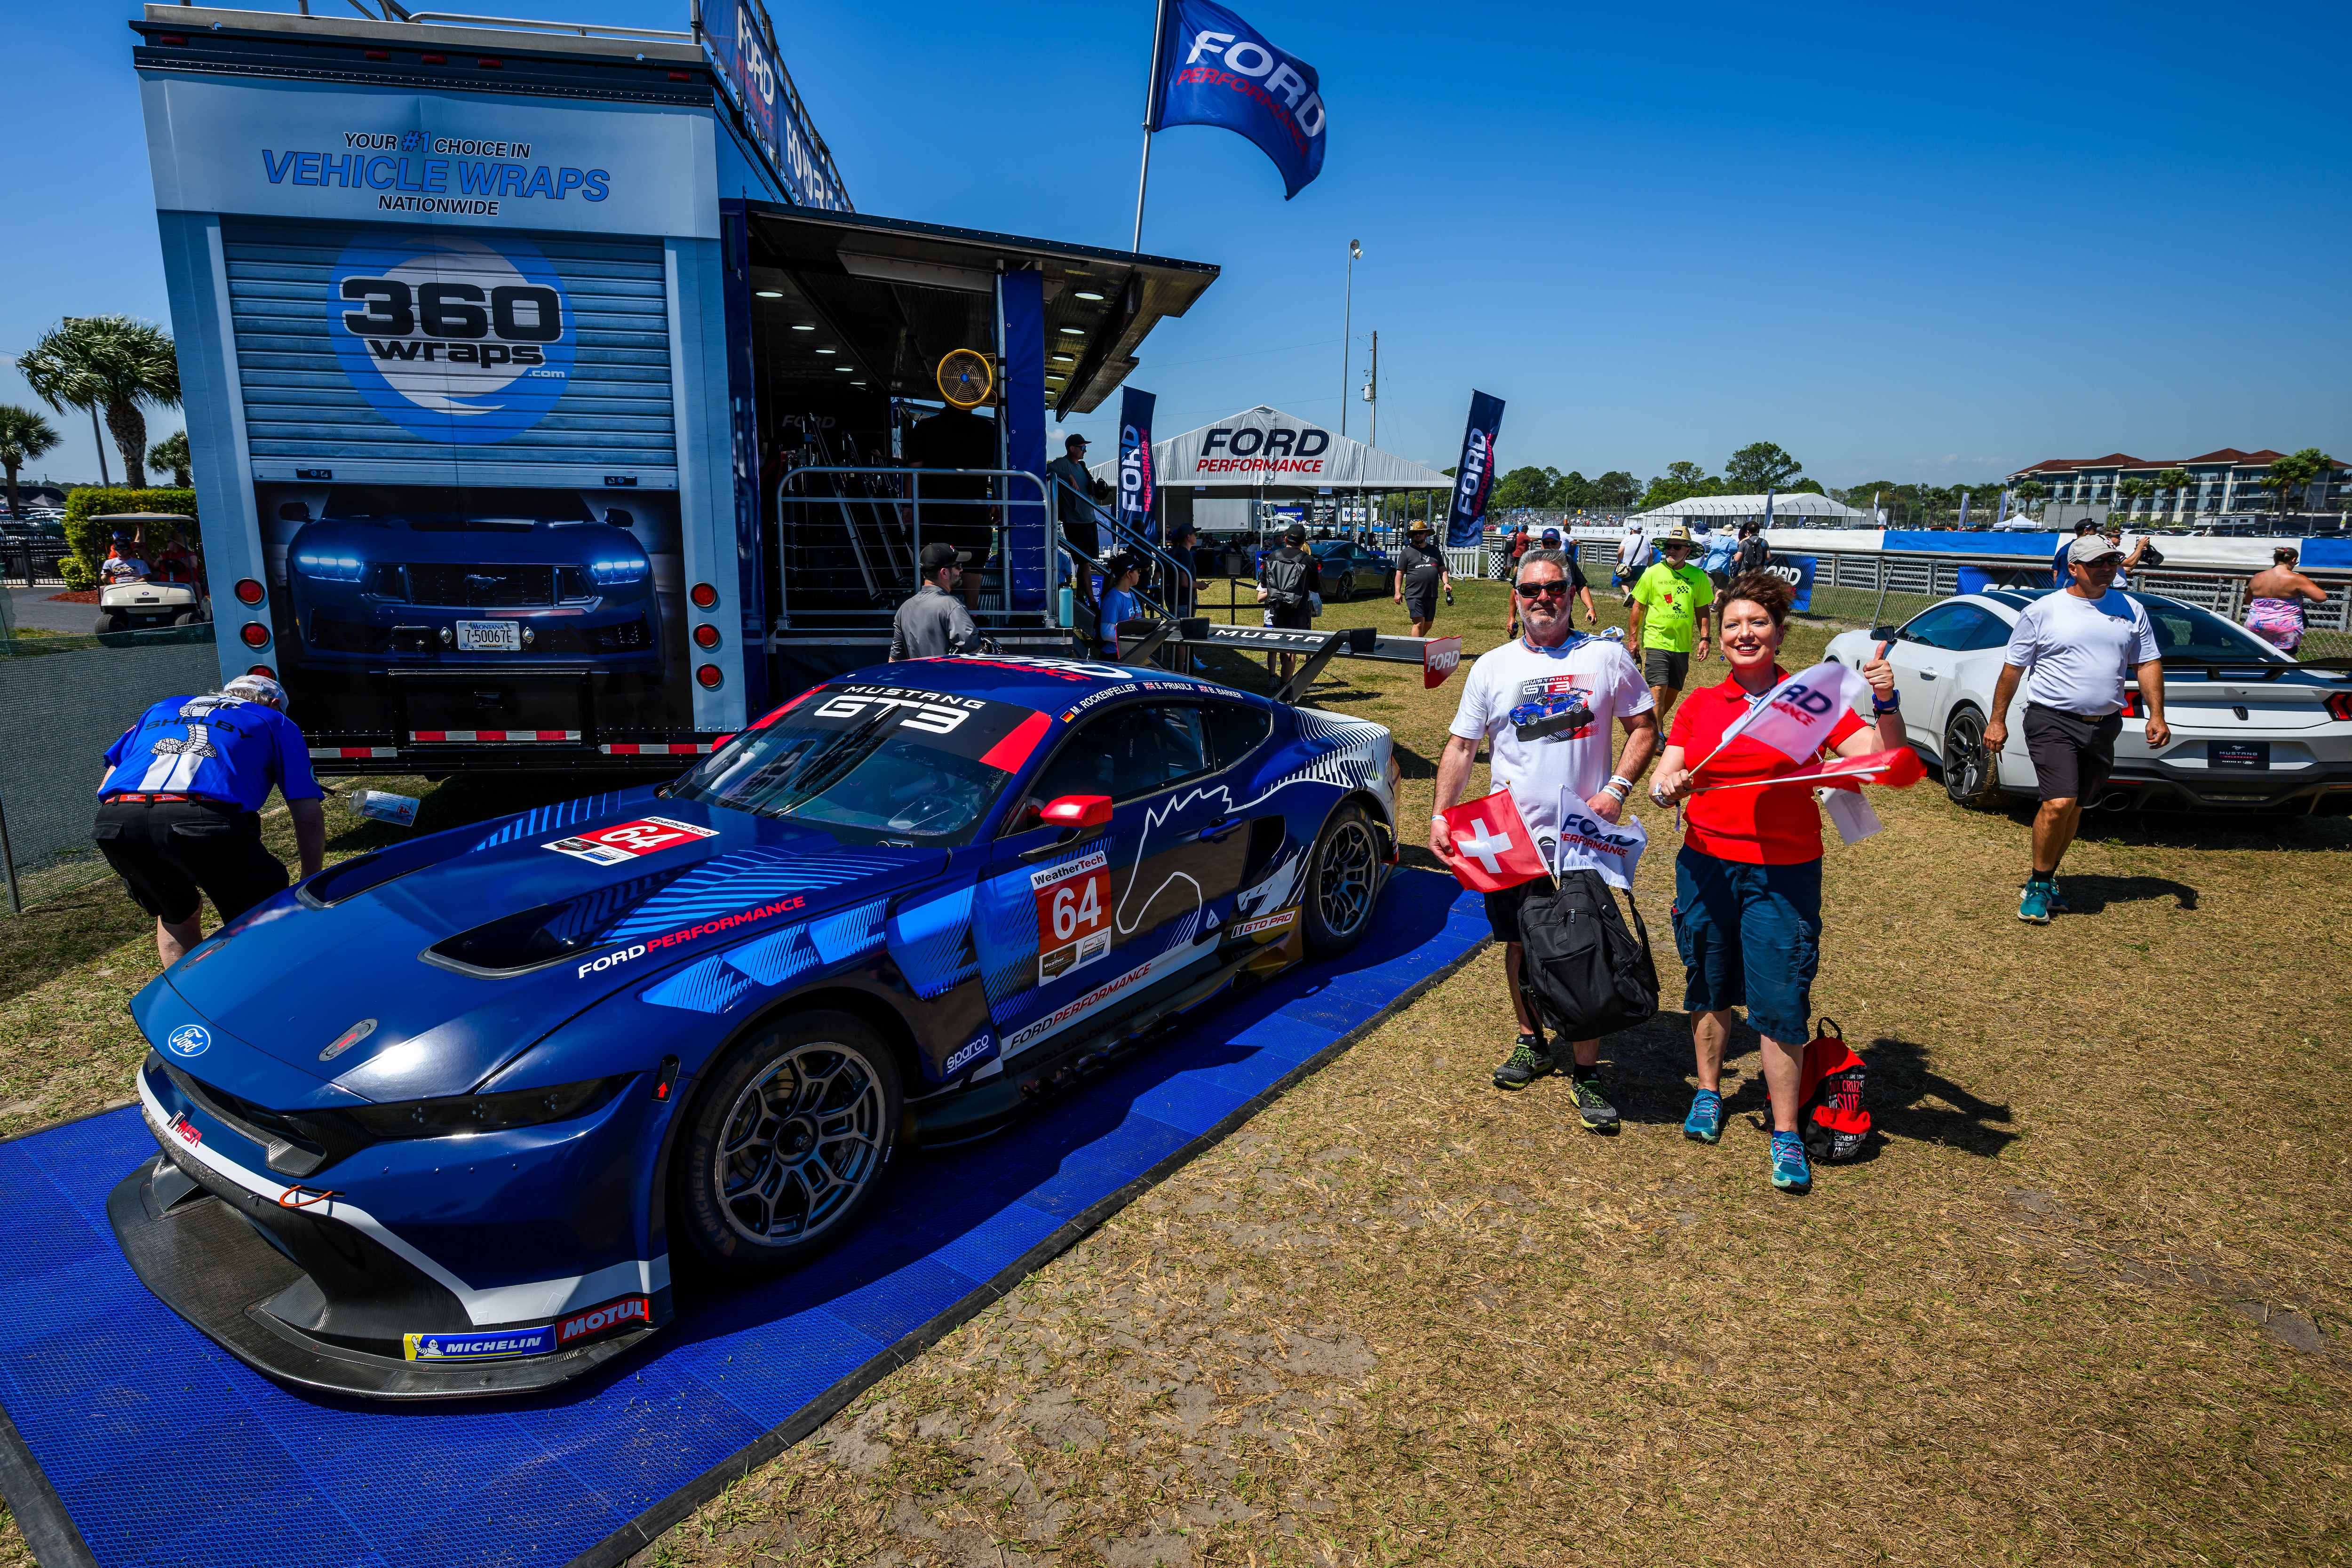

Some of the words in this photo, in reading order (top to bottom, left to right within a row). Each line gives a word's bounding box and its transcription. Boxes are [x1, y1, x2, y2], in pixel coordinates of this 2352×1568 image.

[738, 6, 775, 105] FORD
[737, 52, 774, 131] PERFORMANCE
[1185, 30, 1326, 137] FORD
[1176, 67, 1308, 158] PERFORMANCE
[344, 132, 398, 151] YOUR
[402, 130, 430, 153] #1
[434, 138, 507, 158] CHOICE
[511, 143, 531, 159] IN
[786, 114, 813, 201] FORD
[262, 149, 448, 193] VEHICLE
[459, 161, 610, 202] WRAPS
[378, 194, 500, 216] NATIONWIDE
[342, 277, 562, 341] 360
[369, 340, 545, 369] wraps
[528, 369, 565, 379] .com
[1200, 428, 1330, 456] FORD
[1120, 424, 1142, 512] FORD
[1141, 427, 1152, 512] PERFORMANCE
[1196, 458, 1324, 473] PERFORMANCE
[1458, 428, 1486, 516] FORD
[1472, 432, 1494, 517] PERFORMANCE
[1764, 566, 1801, 586] ORD
[1215, 629, 1327, 644] MUSTA
[1426, 650, 1460, 673] FORD
[1164, 682, 1194, 691] PRIAULX
[1216, 688, 1243, 699] BARKER
[1523, 681, 1570, 695] GT3
[1524, 677, 1569, 686] MUSTANG
[844, 685, 986, 709] MUSTANG
[1070, 706, 1083, 715] M.
[1081, 684, 1138, 708] ROCKENFELLER
[1777, 684, 1833, 714] RD
[145, 716, 254, 740] SHELBY
[814, 696, 970, 734] GT3
[600, 826, 684, 850] 64
[1053, 876, 1102, 940] 64
[1244, 920, 1267, 933] GTD
[1269, 913, 1293, 926] PRO
[172, 1028, 204, 1053] Ford
[947, 1035, 989, 1073] sparco
[705, 1099, 721, 1128] PILOT
[717, 1071, 740, 1100] SPORT
[1842, 1080, 1861, 1093] CRUZ
[175, 1119, 202, 1148] IMSA
[693, 1144, 719, 1233] MICHELIN
[563, 1301, 645, 1339] MOTUL
[446, 1337, 541, 1353] MICHELIN
